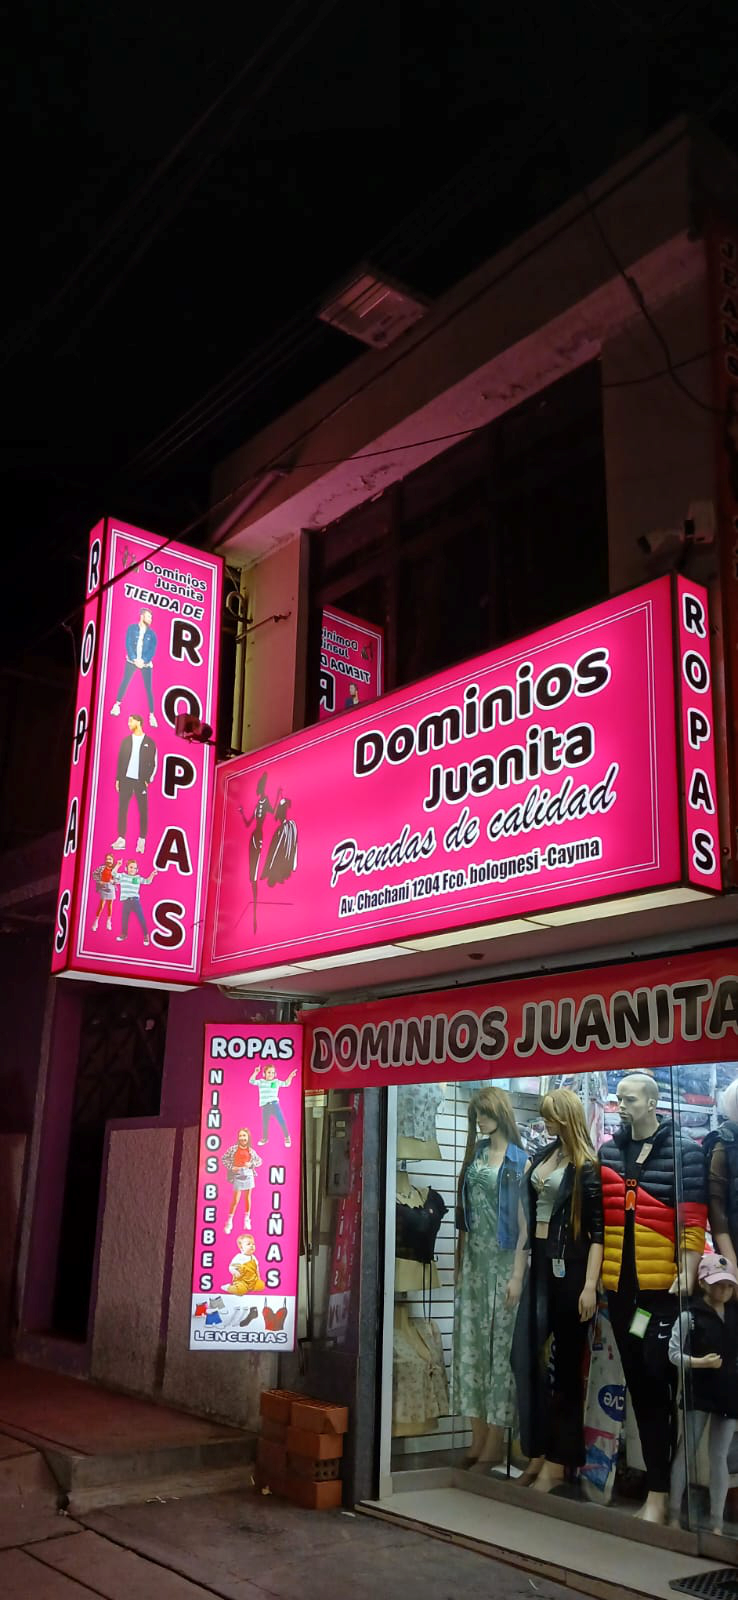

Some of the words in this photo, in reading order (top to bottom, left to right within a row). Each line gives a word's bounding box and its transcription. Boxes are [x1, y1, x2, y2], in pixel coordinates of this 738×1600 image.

[125, 584, 180, 613] TIENDA
[182, 603, 204, 620] DE
[144, 560, 206, 590] Dominios
[155, 577, 204, 602] Juanita
[55, 539, 101, 953] ROPAS
[355, 648, 611, 777] Dominios
[682, 593, 716, 875] ROPAS
[151, 618, 203, 950] ROPAS
[424, 723, 594, 812] Juanita
[331, 825, 435, 886] Prendas
[444, 808, 479, 850] de
[488, 764, 618, 840] calidad
[340, 897, 355, 916] Av.
[356, 882, 410, 911] Chachani
[412, 875, 440, 898] 1204
[442, 871, 467, 891] Fco.
[469, 850, 539, 885] bolognesi
[211, 1037, 294, 1060] ROPAS
[311, 1006, 508, 1073] DOMINIOS
[514, 976, 738, 1057] JUANITA
[206, 1068, 223, 1172] NIÑOS
[200, 1184, 217, 1292] BEBES
[266, 1166, 285, 1288] NIÑAS
[194, 1330, 287, 1344] LENCERIAS
